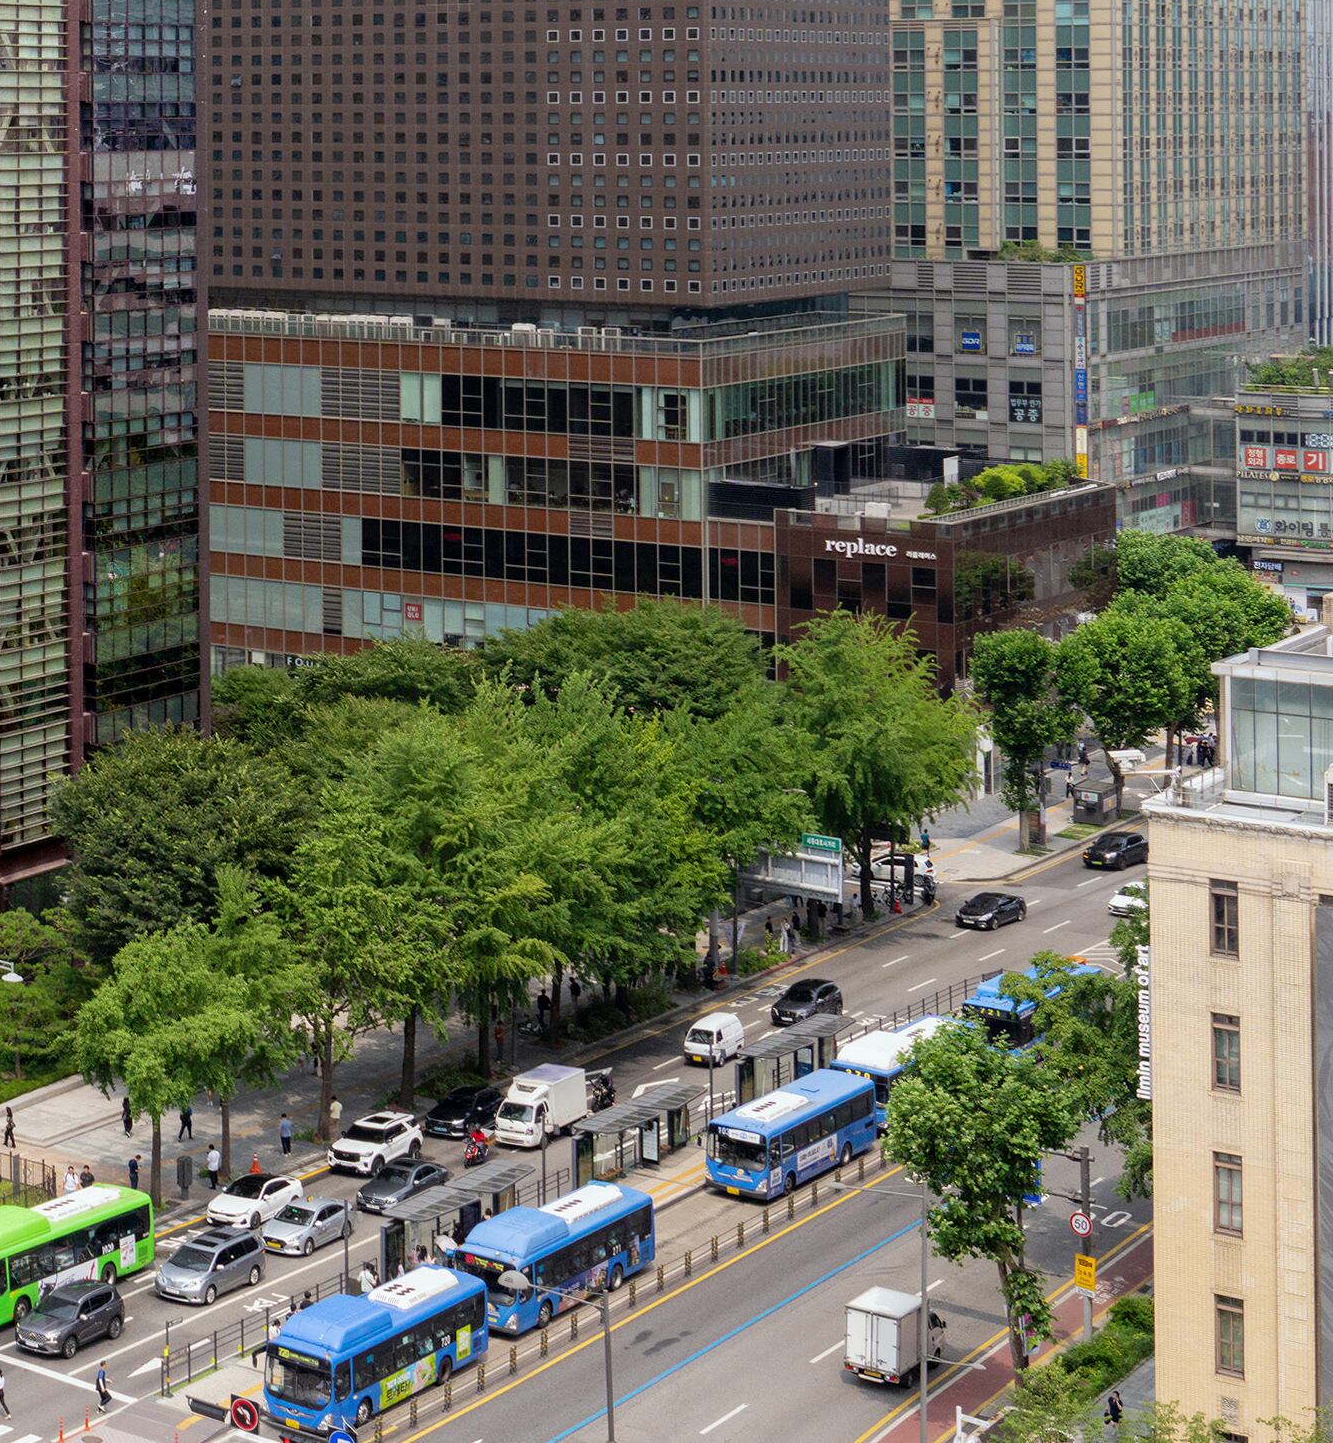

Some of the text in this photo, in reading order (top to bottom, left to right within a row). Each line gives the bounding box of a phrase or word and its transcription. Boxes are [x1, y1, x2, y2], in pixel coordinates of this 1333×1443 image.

[1276, 454, 1296, 465] 종로
[825, 537, 898, 558] replace
[1253, 561, 1283, 571] 전자담배
[1135, 944, 1150, 967] art
[1132, 965, 1150, 986] of
[1137, 989, 1150, 1058] museum
[1074, 1218, 1088, 1231] 50
